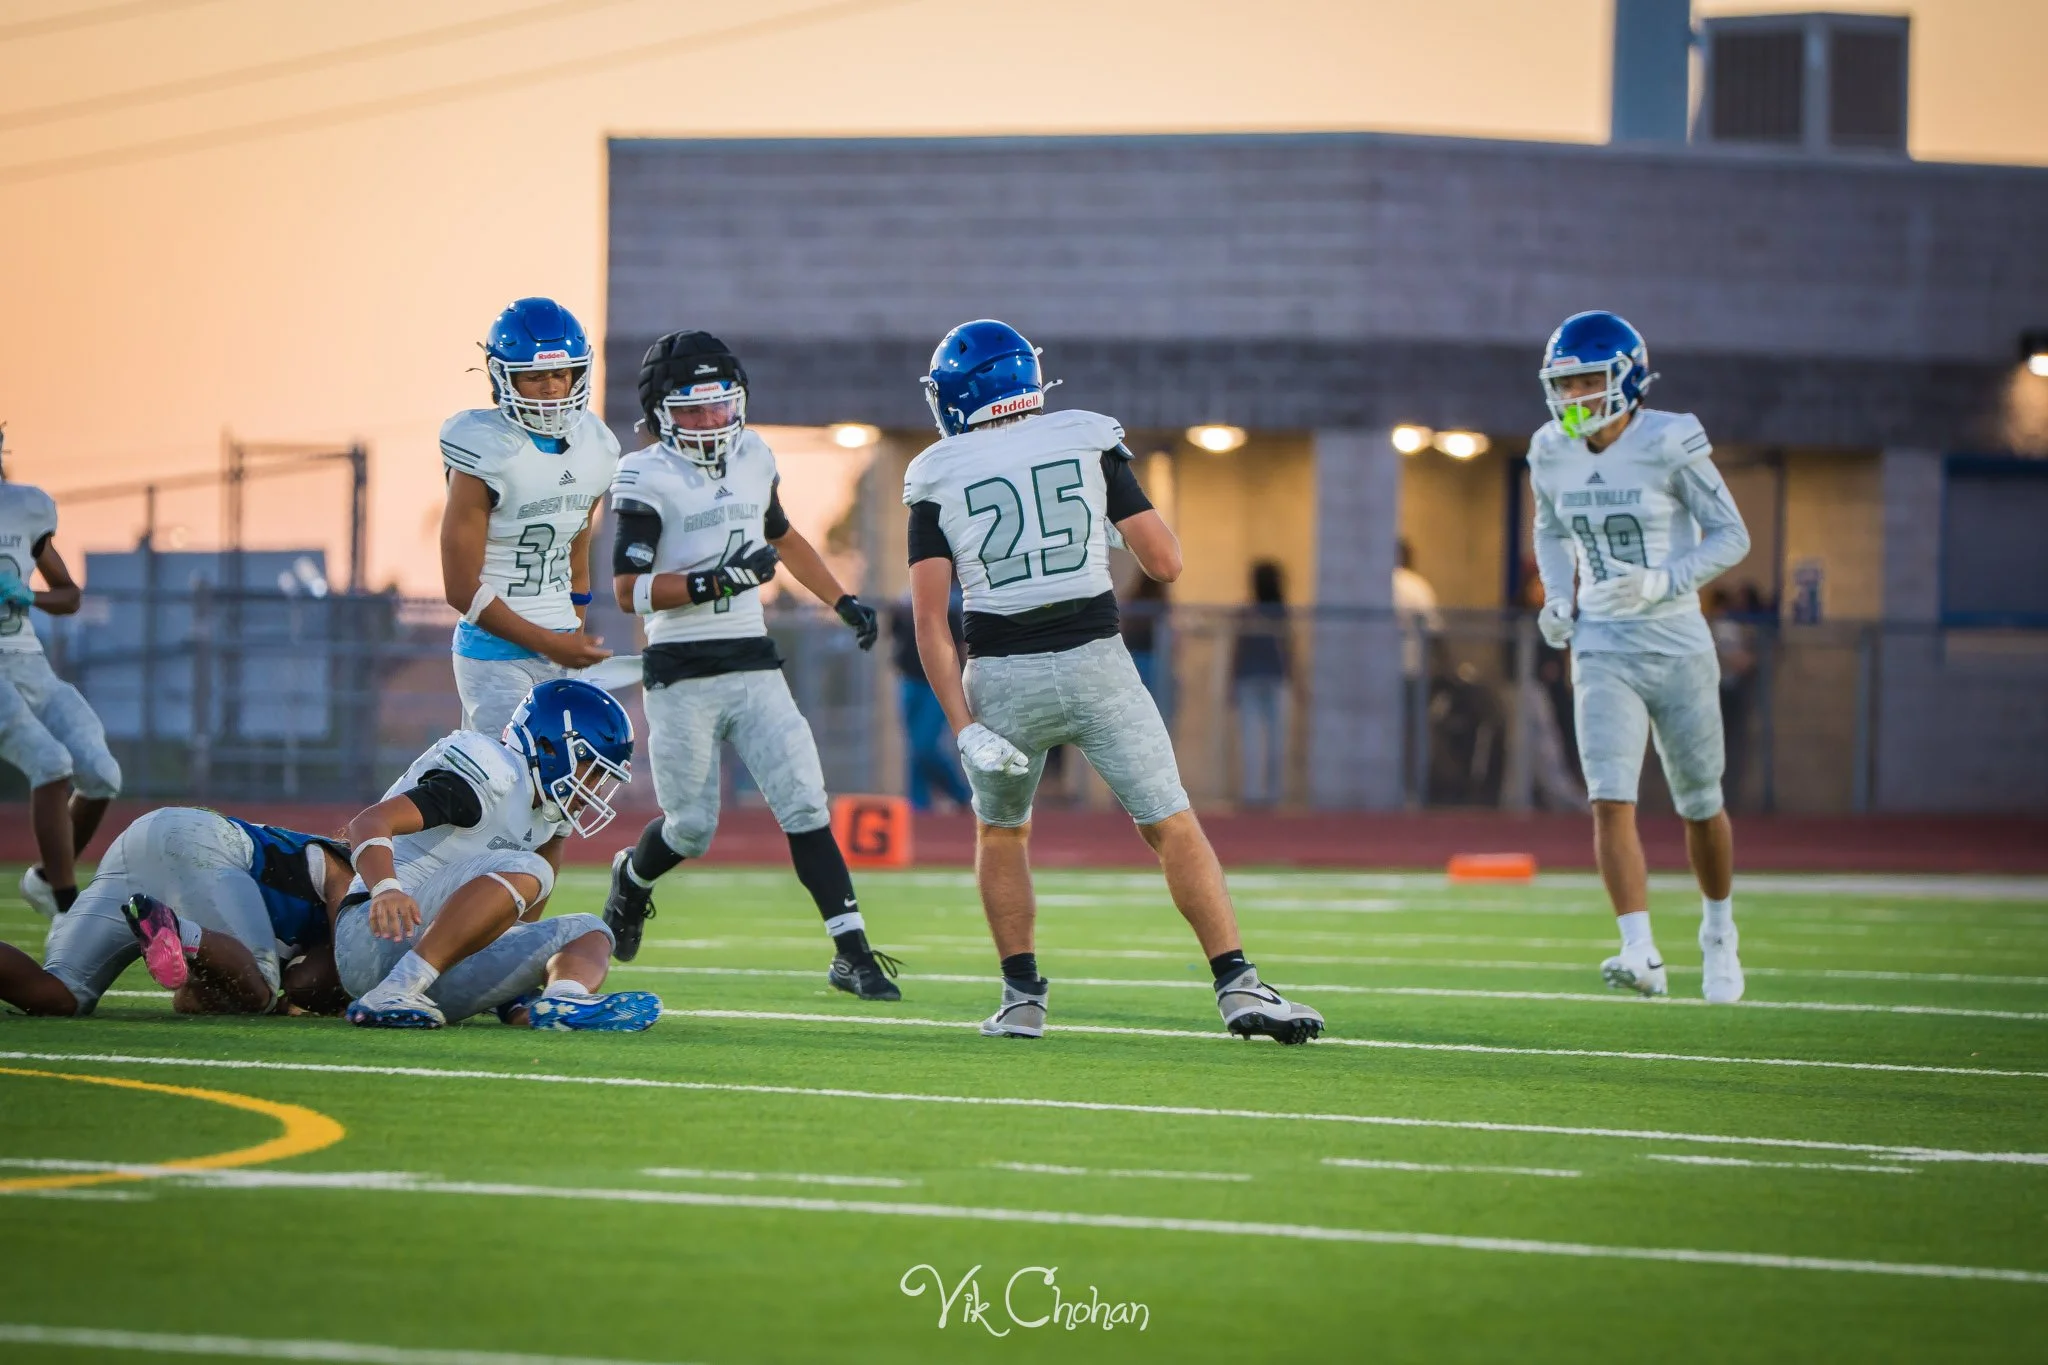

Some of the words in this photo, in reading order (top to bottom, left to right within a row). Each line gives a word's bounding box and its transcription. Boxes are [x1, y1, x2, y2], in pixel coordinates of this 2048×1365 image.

[991, 395, 1039, 416] Riddell
[963, 458, 1093, 590] 25
[849, 803, 890, 857] G
